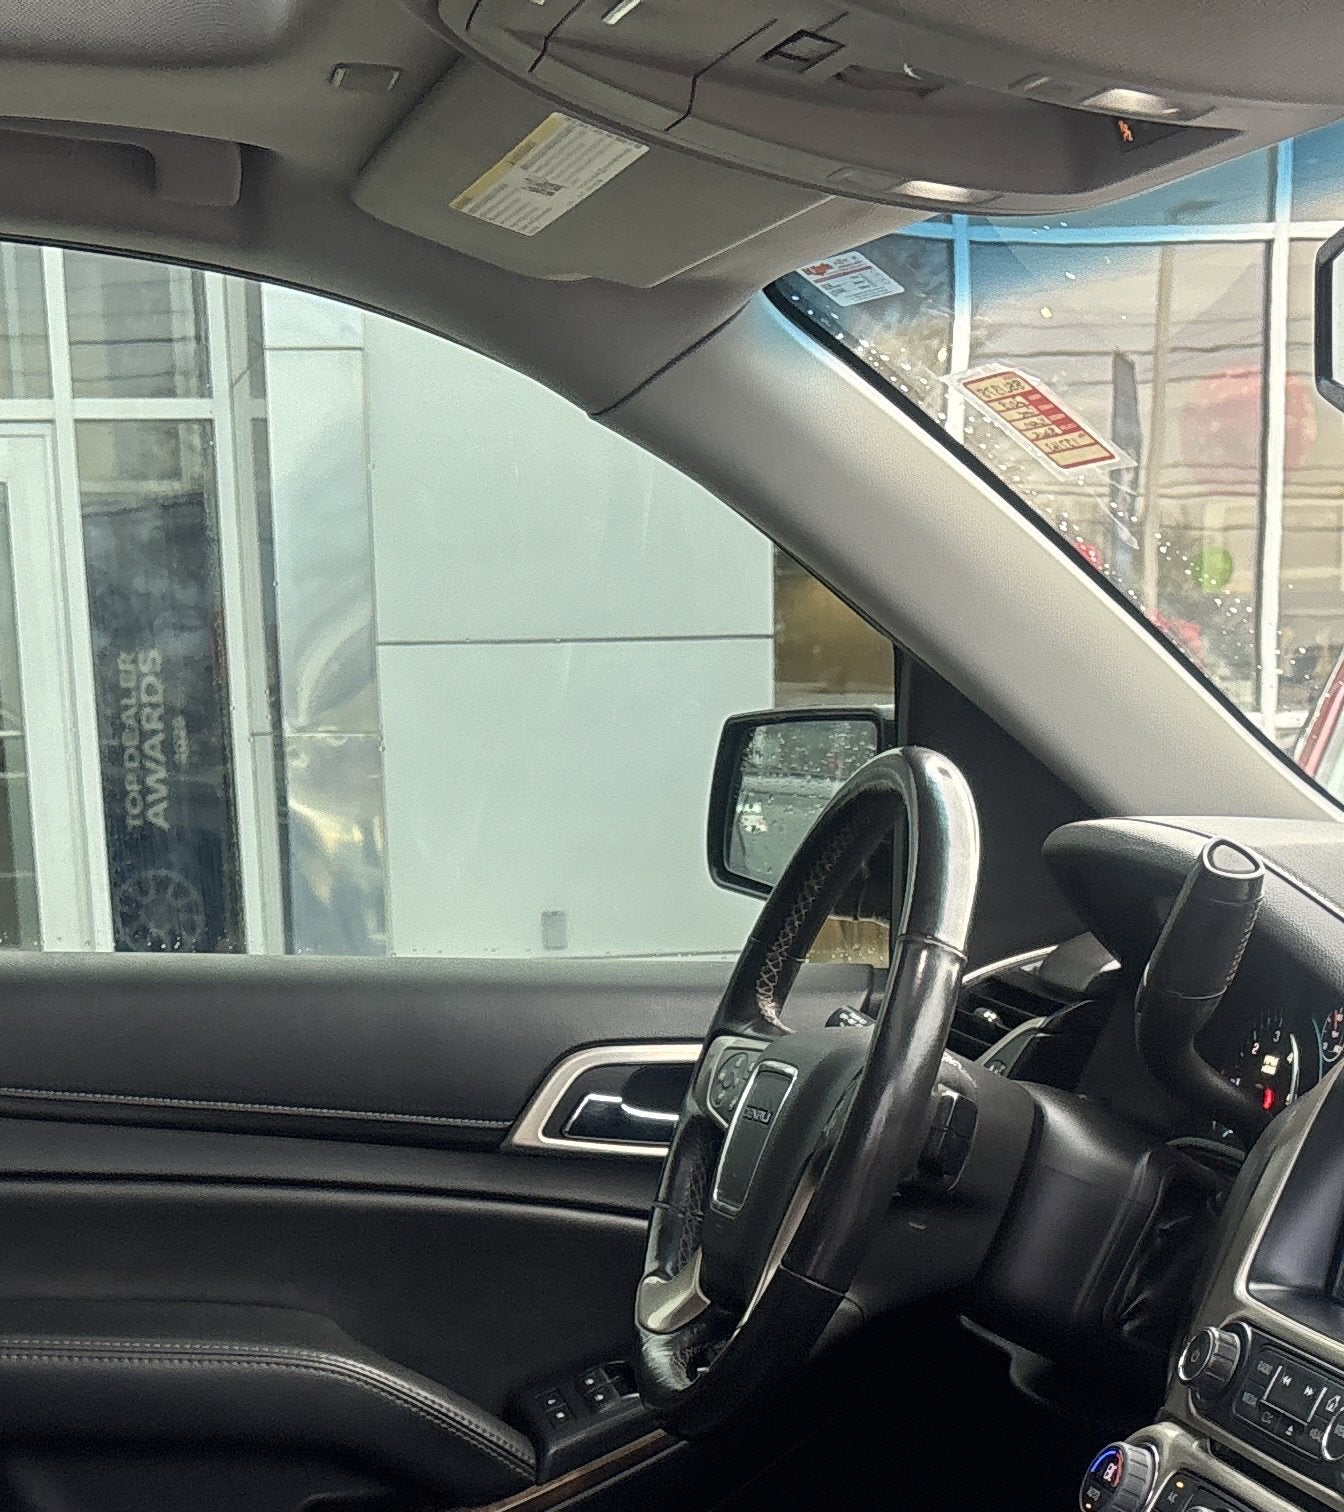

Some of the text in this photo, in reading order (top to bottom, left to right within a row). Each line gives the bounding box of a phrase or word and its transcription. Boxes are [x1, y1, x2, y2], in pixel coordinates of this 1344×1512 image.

[118, 651, 144, 832] TOP DEALER
[141, 648, 170, 832] AWARDS
[1251, 1043, 1260, 1055] 2
